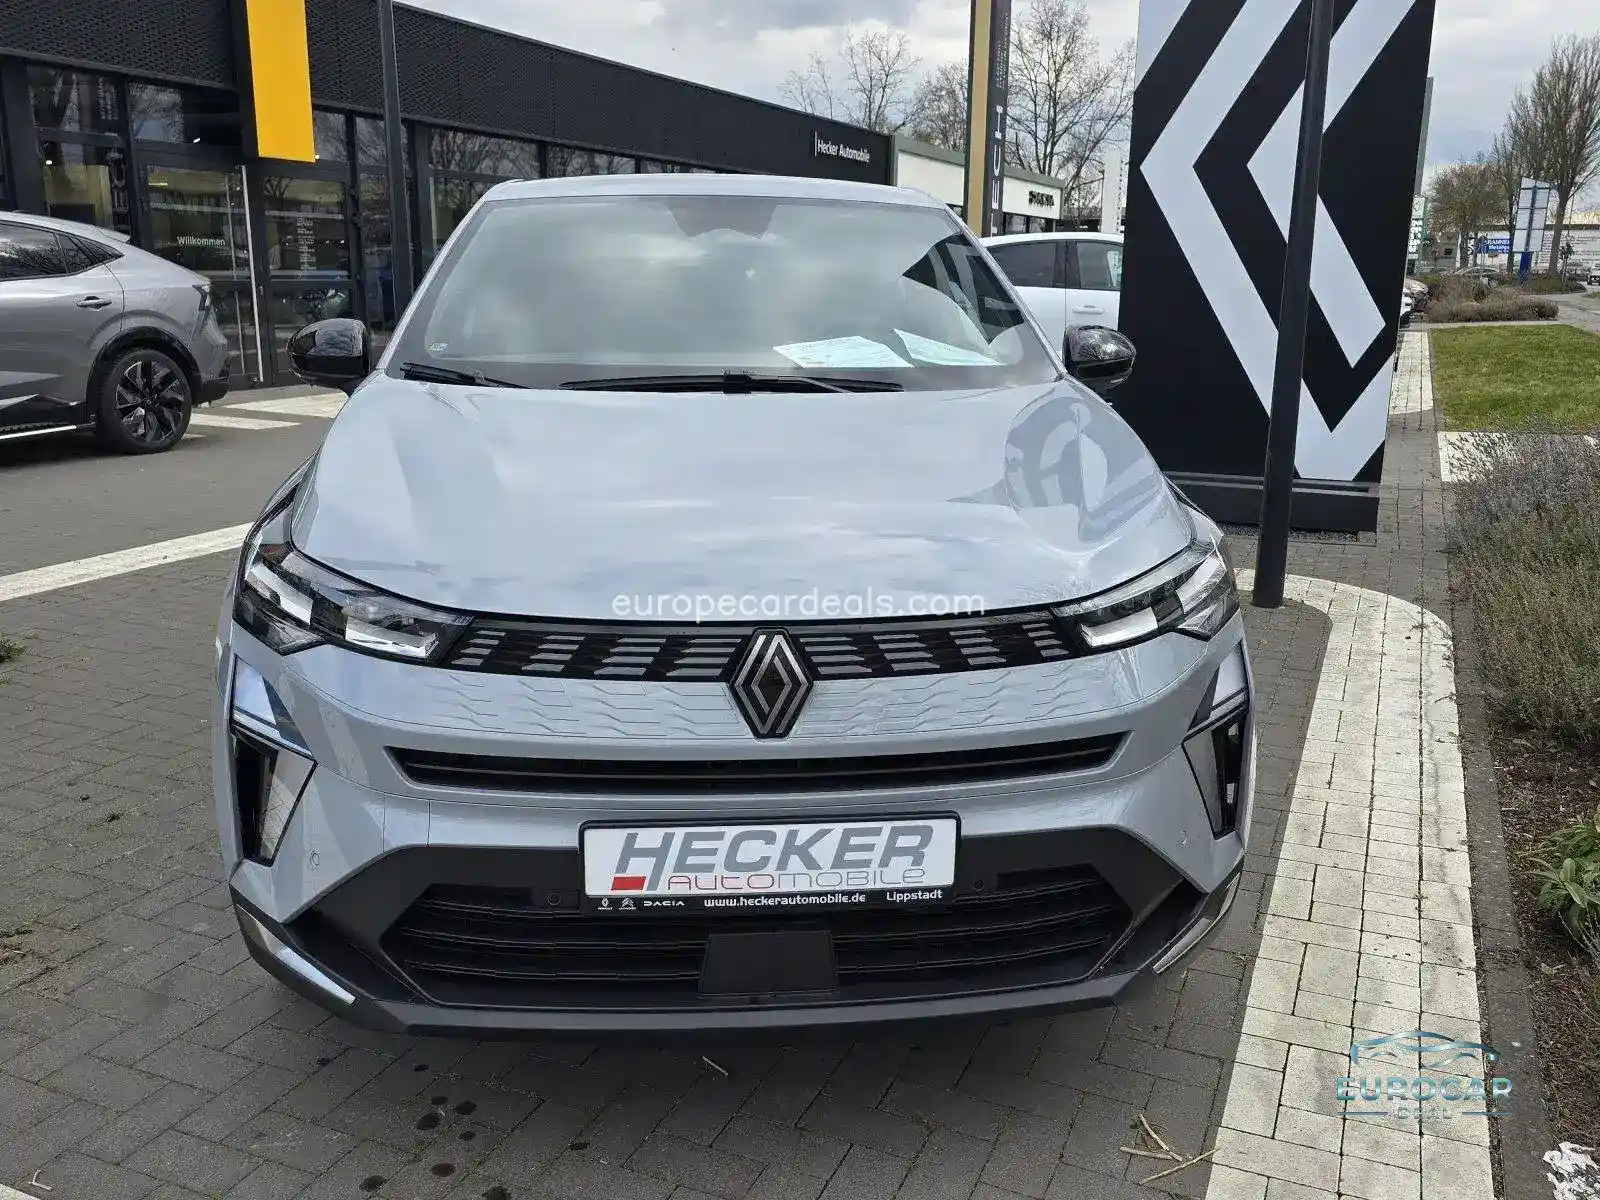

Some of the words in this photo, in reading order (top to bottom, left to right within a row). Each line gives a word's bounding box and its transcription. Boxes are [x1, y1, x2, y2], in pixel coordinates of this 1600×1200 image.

[818, 139, 838, 156] Hecker
[839, 144, 870, 162] Automobile
[177, 235, 226, 247] Willkommen
[614, 825, 934, 892] HECKER
[704, 893, 866, 908] www.heckerautomobile.de
[886, 889, 943, 902] Lippstadt
